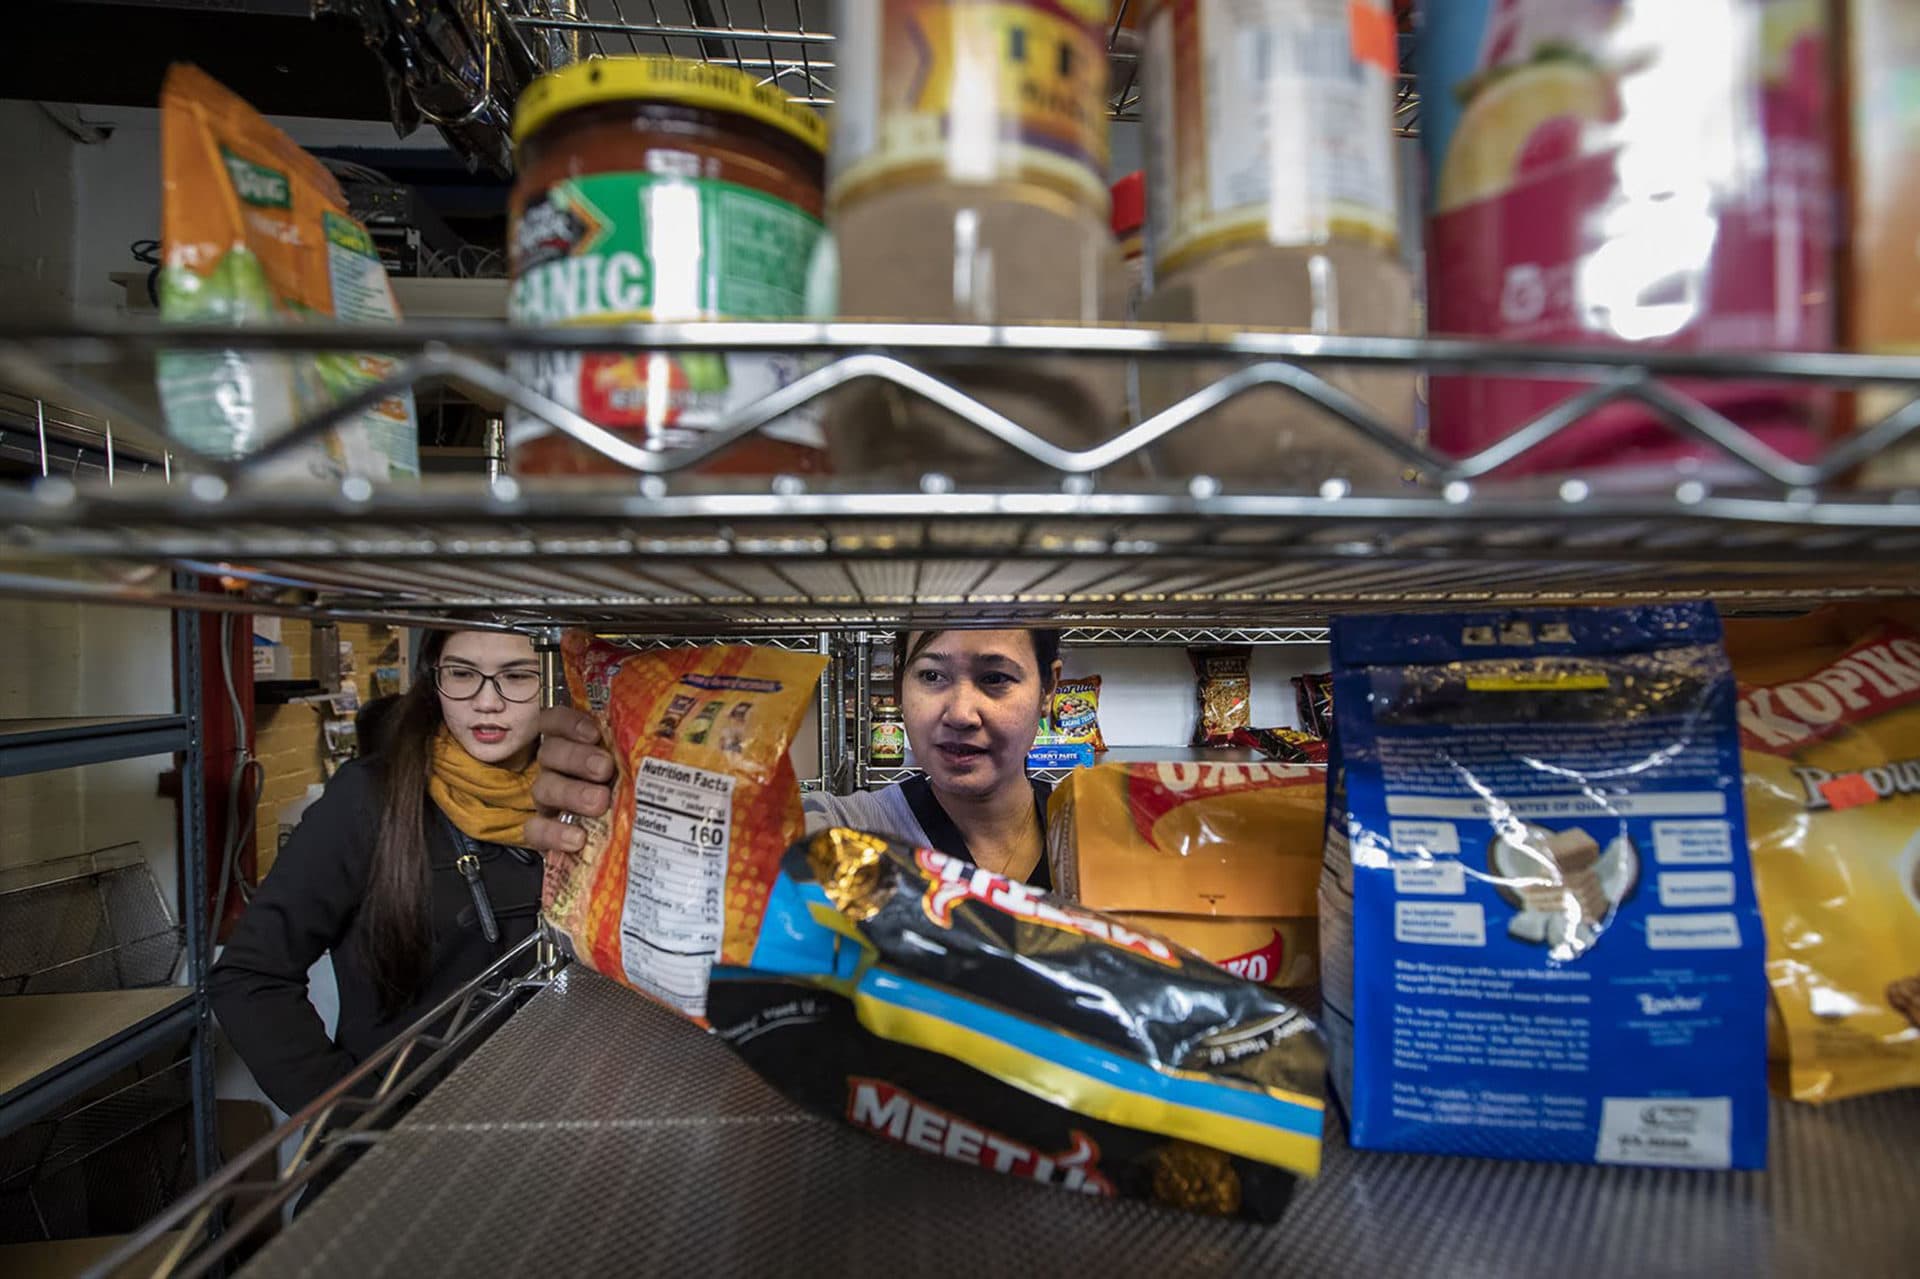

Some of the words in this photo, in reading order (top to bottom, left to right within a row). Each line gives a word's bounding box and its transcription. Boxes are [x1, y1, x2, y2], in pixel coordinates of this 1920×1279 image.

[642, 760, 690, 784] Nutrition
[693, 771, 729, 793] Facts
[690, 825, 723, 846] 160
